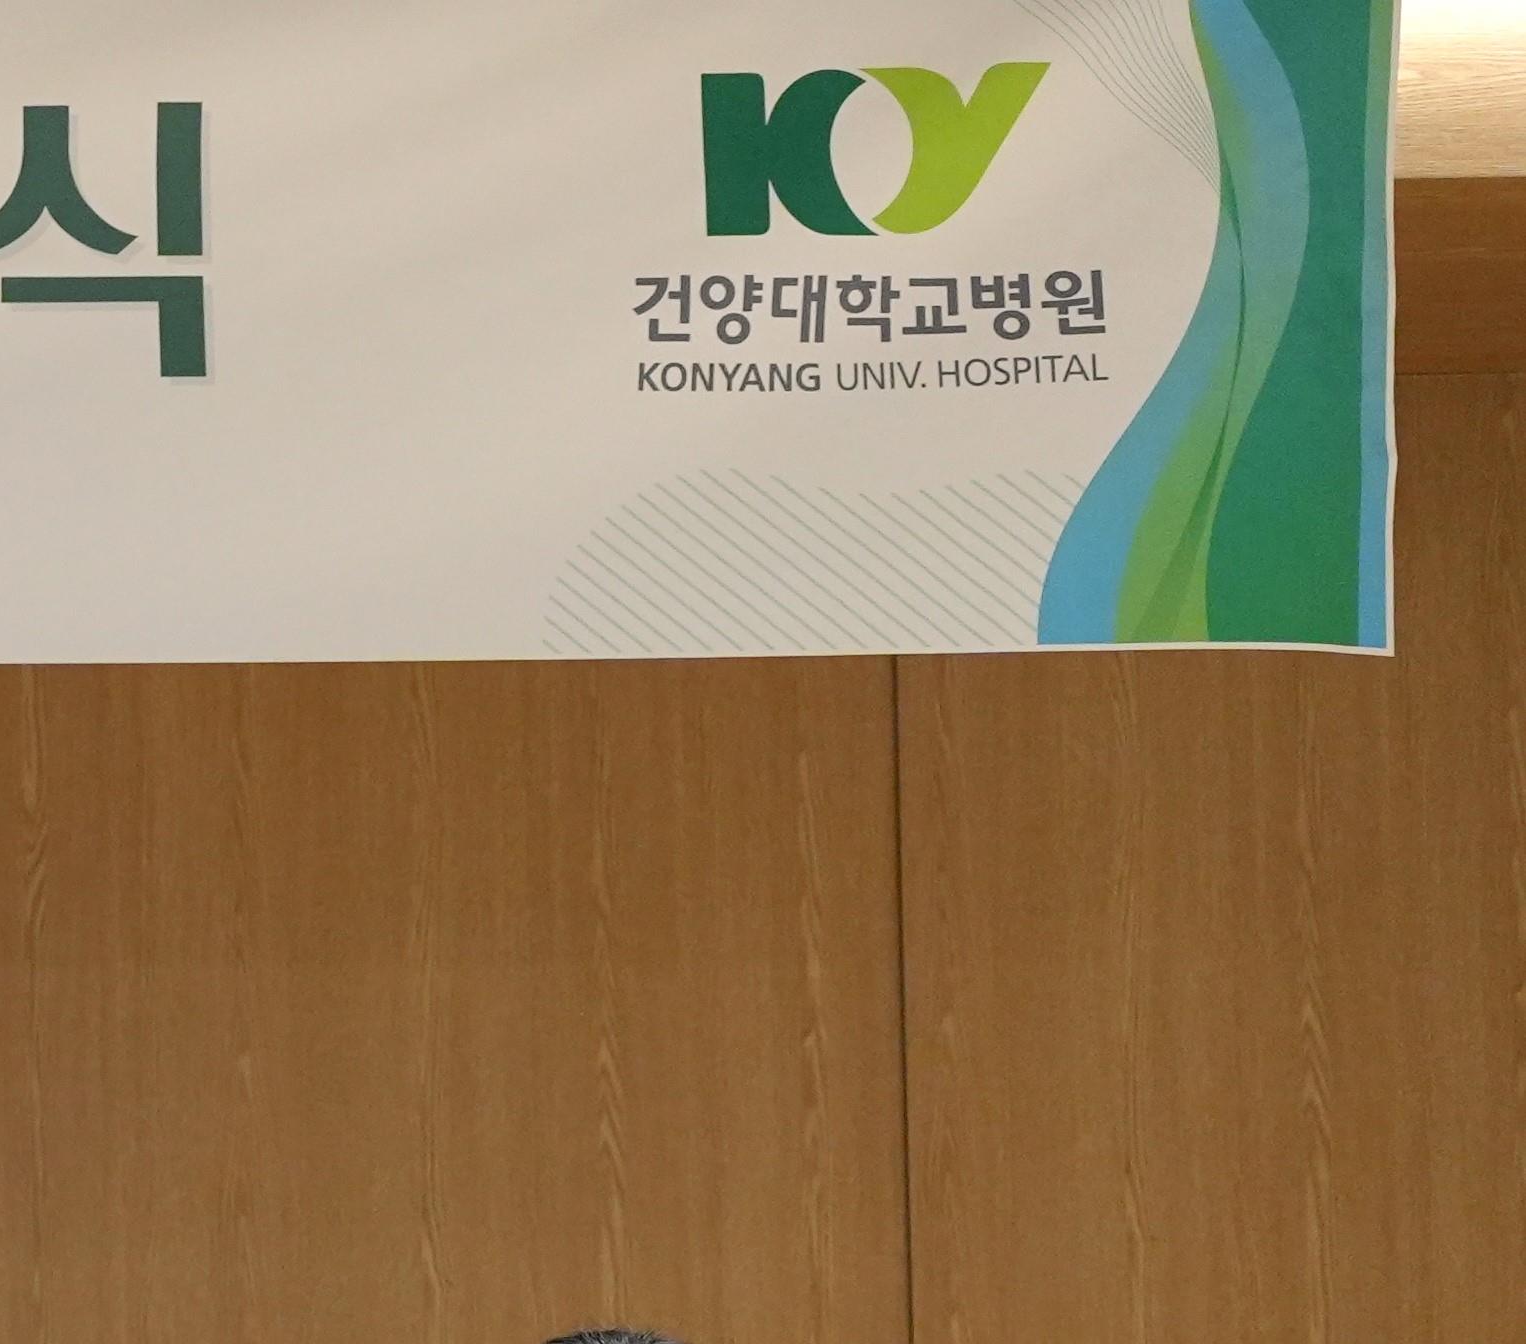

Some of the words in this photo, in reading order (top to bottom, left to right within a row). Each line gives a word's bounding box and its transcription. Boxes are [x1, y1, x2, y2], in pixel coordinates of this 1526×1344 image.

[701, 62, 1050, 236] KY
[634, 270, 1105, 344] 건양대학교병원
[639, 363, 820, 391] KONYANG
[837, 361, 926, 390] UNIV.
[938, 354, 1108, 387] HOSPITAL
